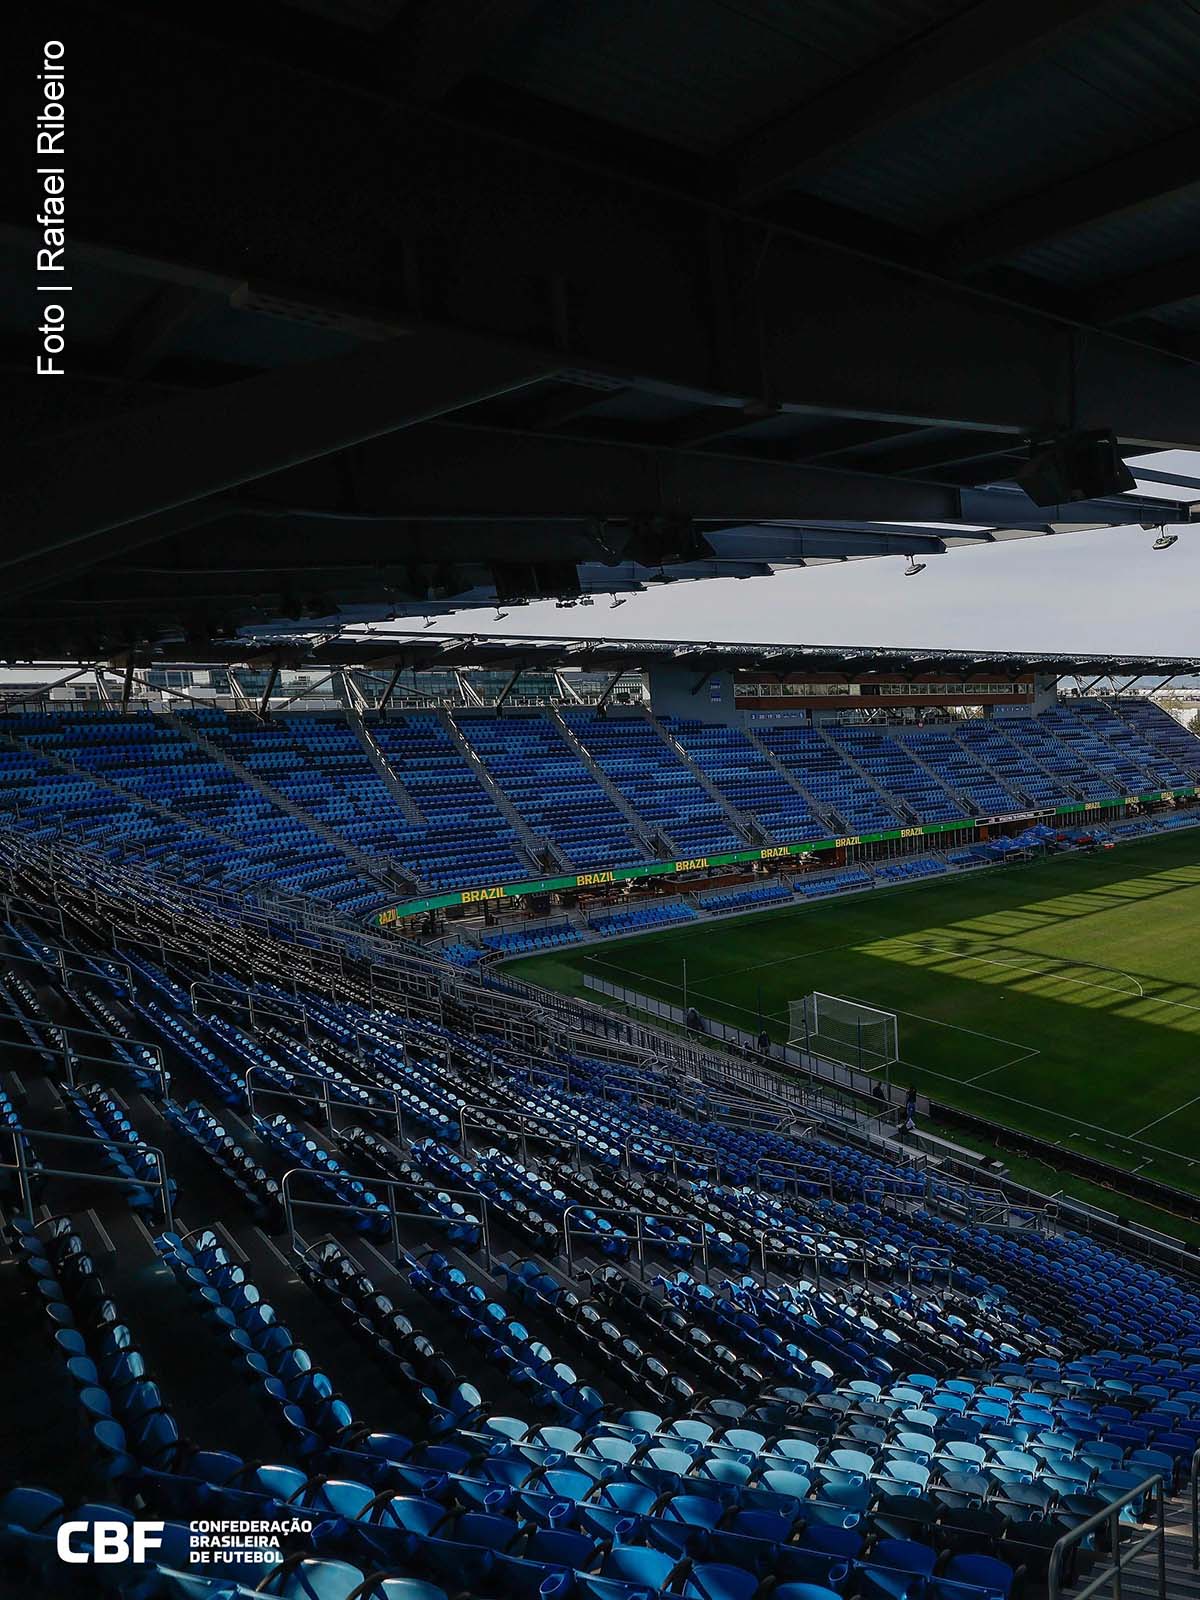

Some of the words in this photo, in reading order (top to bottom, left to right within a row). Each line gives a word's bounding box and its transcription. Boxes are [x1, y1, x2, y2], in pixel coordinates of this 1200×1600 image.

[900, 827, 925, 838] BRAZIL
[835, 836, 862, 848] BRAZIL
[760, 847, 791, 859] BRAZIL
[675, 858, 710, 872] BRAZIL
[576, 871, 616, 886] BRAZIL
[462, 887, 508, 903] BRAZIL
